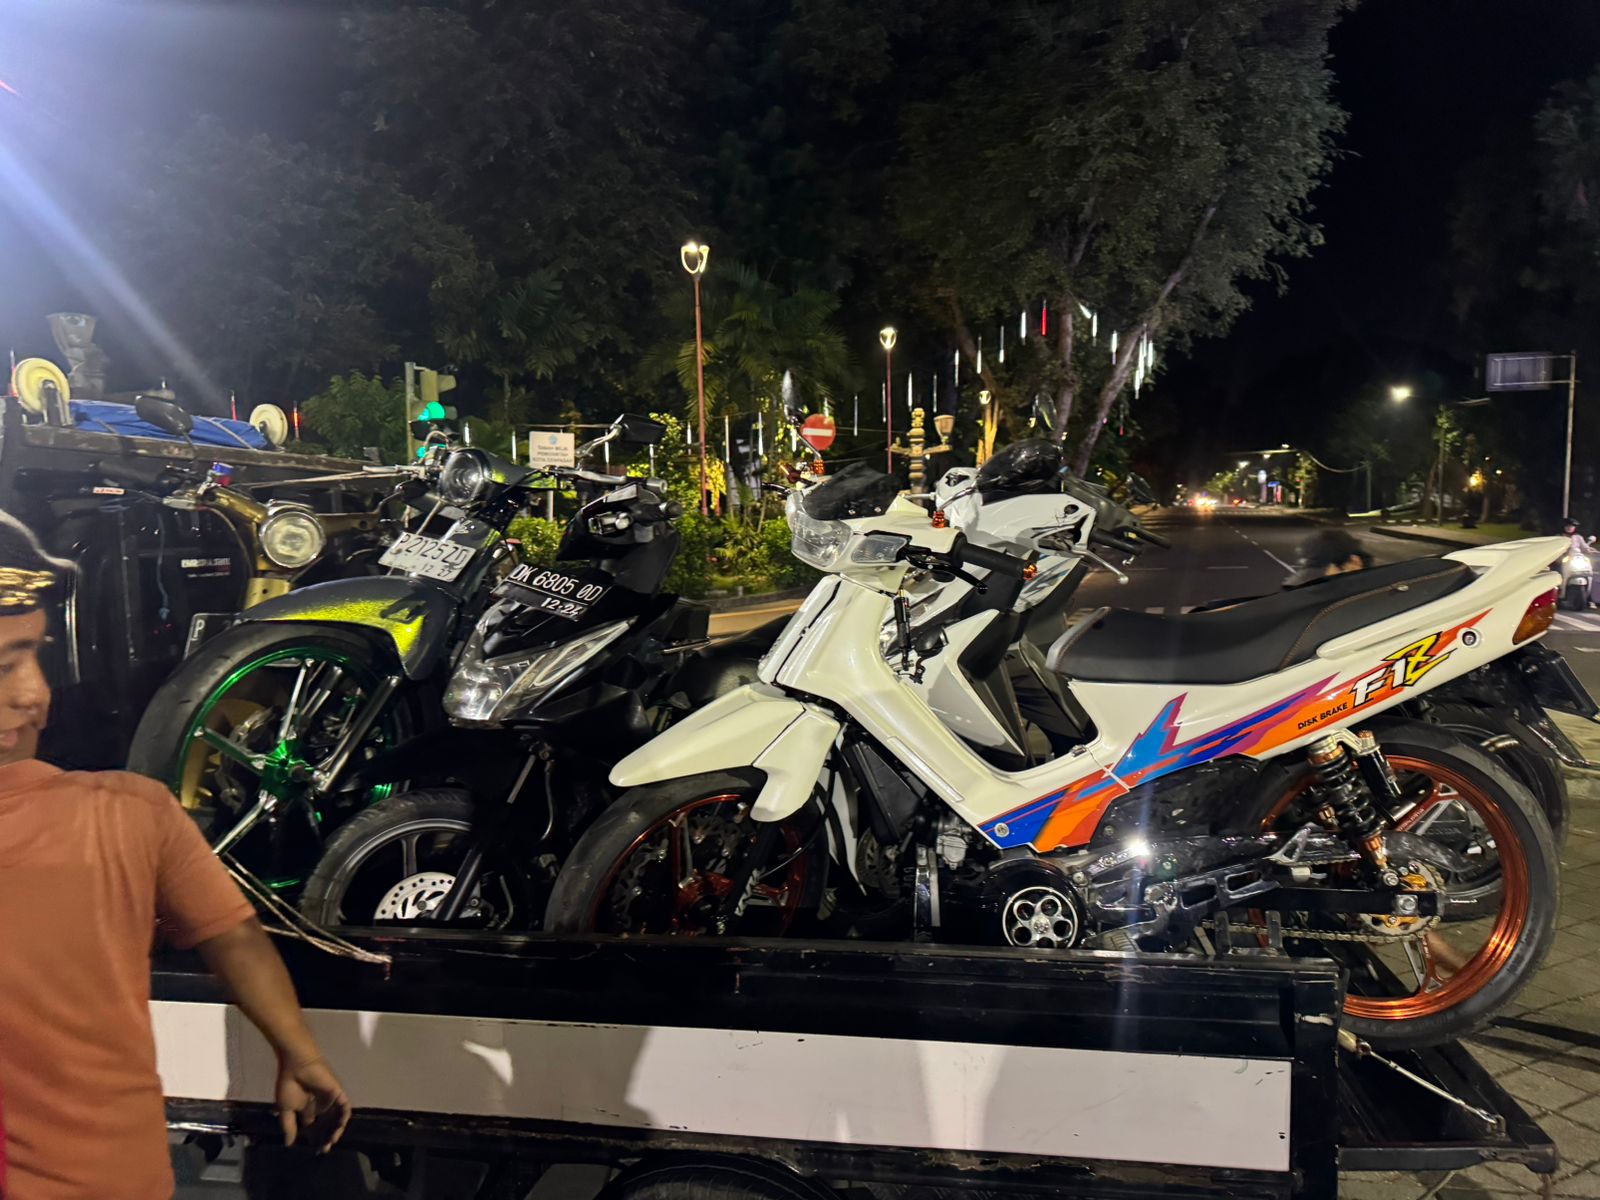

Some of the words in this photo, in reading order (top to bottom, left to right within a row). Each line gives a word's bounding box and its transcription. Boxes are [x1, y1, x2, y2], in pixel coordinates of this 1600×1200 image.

[509, 563, 539, 583] DK
[532, 571, 580, 595] 6805
[1297, 713, 1318, 730] DISK
[1320, 702, 1348, 720] BRAKE
